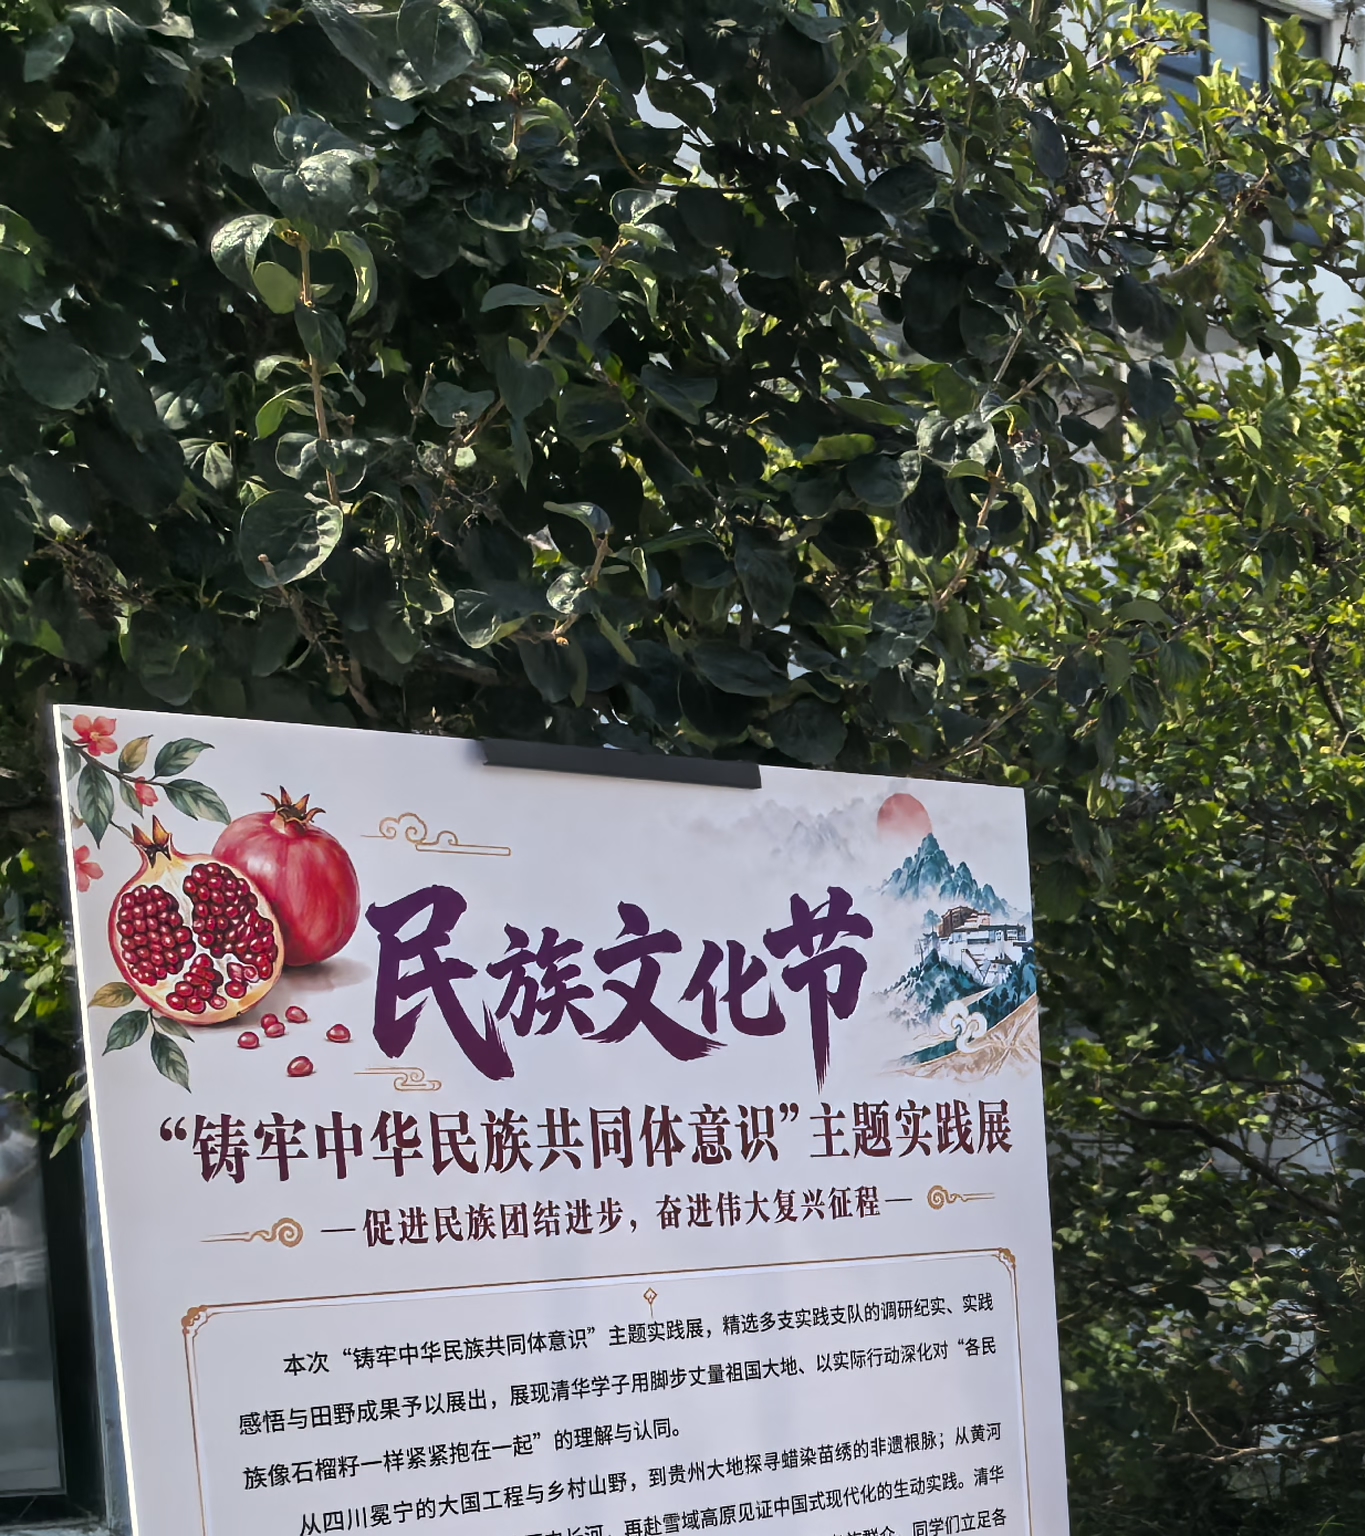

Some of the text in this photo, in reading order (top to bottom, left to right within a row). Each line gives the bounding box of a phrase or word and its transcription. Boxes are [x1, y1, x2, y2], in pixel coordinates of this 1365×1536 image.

[365, 885, 875, 1091] 民族文化节
[160, 1099, 1015, 1184] “铸牢中华民族共同体意识”主题实践展
[283, 1292, 995, 1376] 本次“铸牢中华民族共同体意识”主题实践展，精选多支实践支队的调研纪实、实践
[239, 1336, 998, 1439] 感悟与田野成果予以展出，展现清华学子用脚步丈量祖国大地、以实际行动深化对“各民
[243, 1418, 681, 1490] 族像石榴籽一样紧紧抱在一起”的理解与认同。
[299, 1422, 1003, 1536] 从四川冕宁的大国工程与乡村山野，到贵州大地探寻蜡染苗绣的非遗根脉；从黄河
